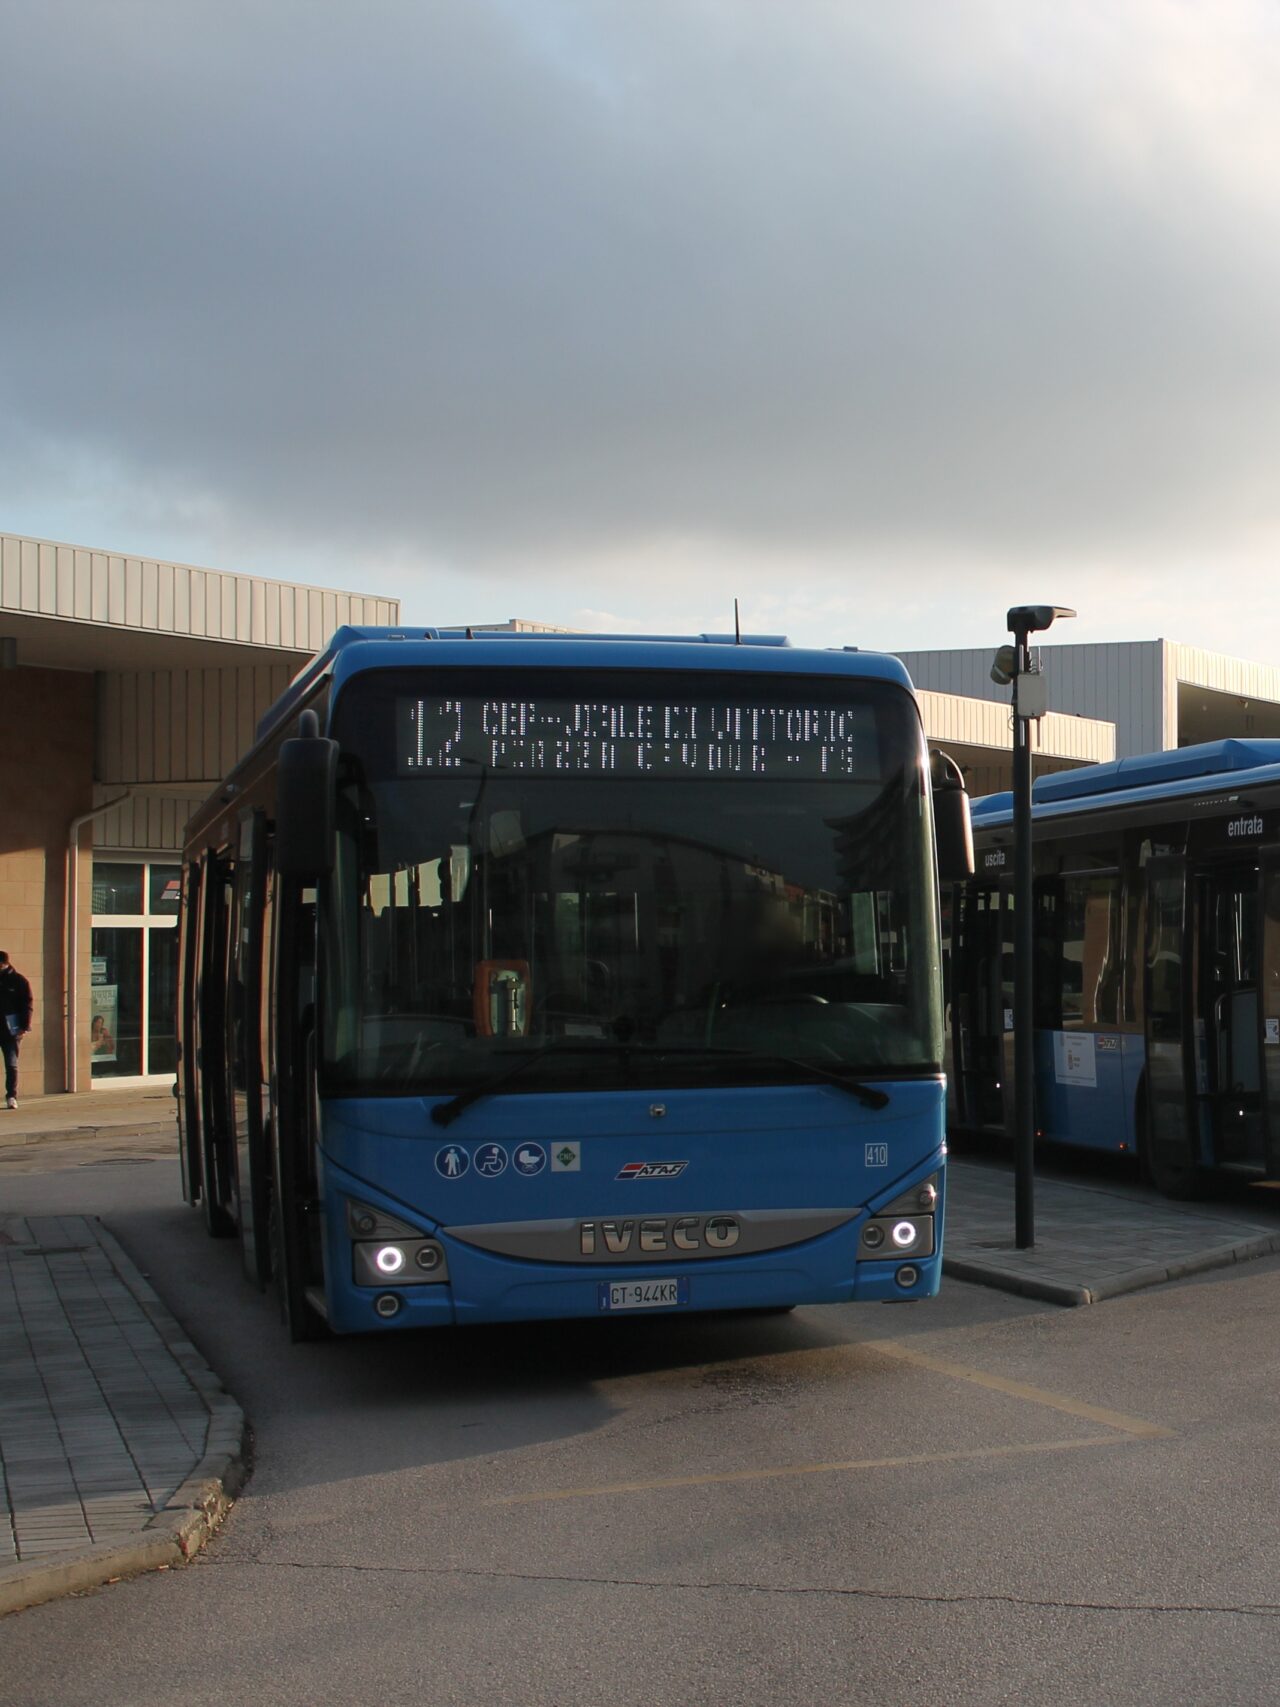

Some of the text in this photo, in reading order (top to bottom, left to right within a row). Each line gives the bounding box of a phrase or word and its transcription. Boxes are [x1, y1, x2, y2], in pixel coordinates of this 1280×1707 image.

[408, 700, 462, 766] 12
[1227, 815, 1263, 837] entrata
[984, 850, 1006, 868] uscita
[867, 1145, 887, 1164] 410
[638, 1163, 682, 1176] ATAF
[579, 1216, 741, 1255] IVECO
[611, 1283, 678, 1305] GT-944KR
